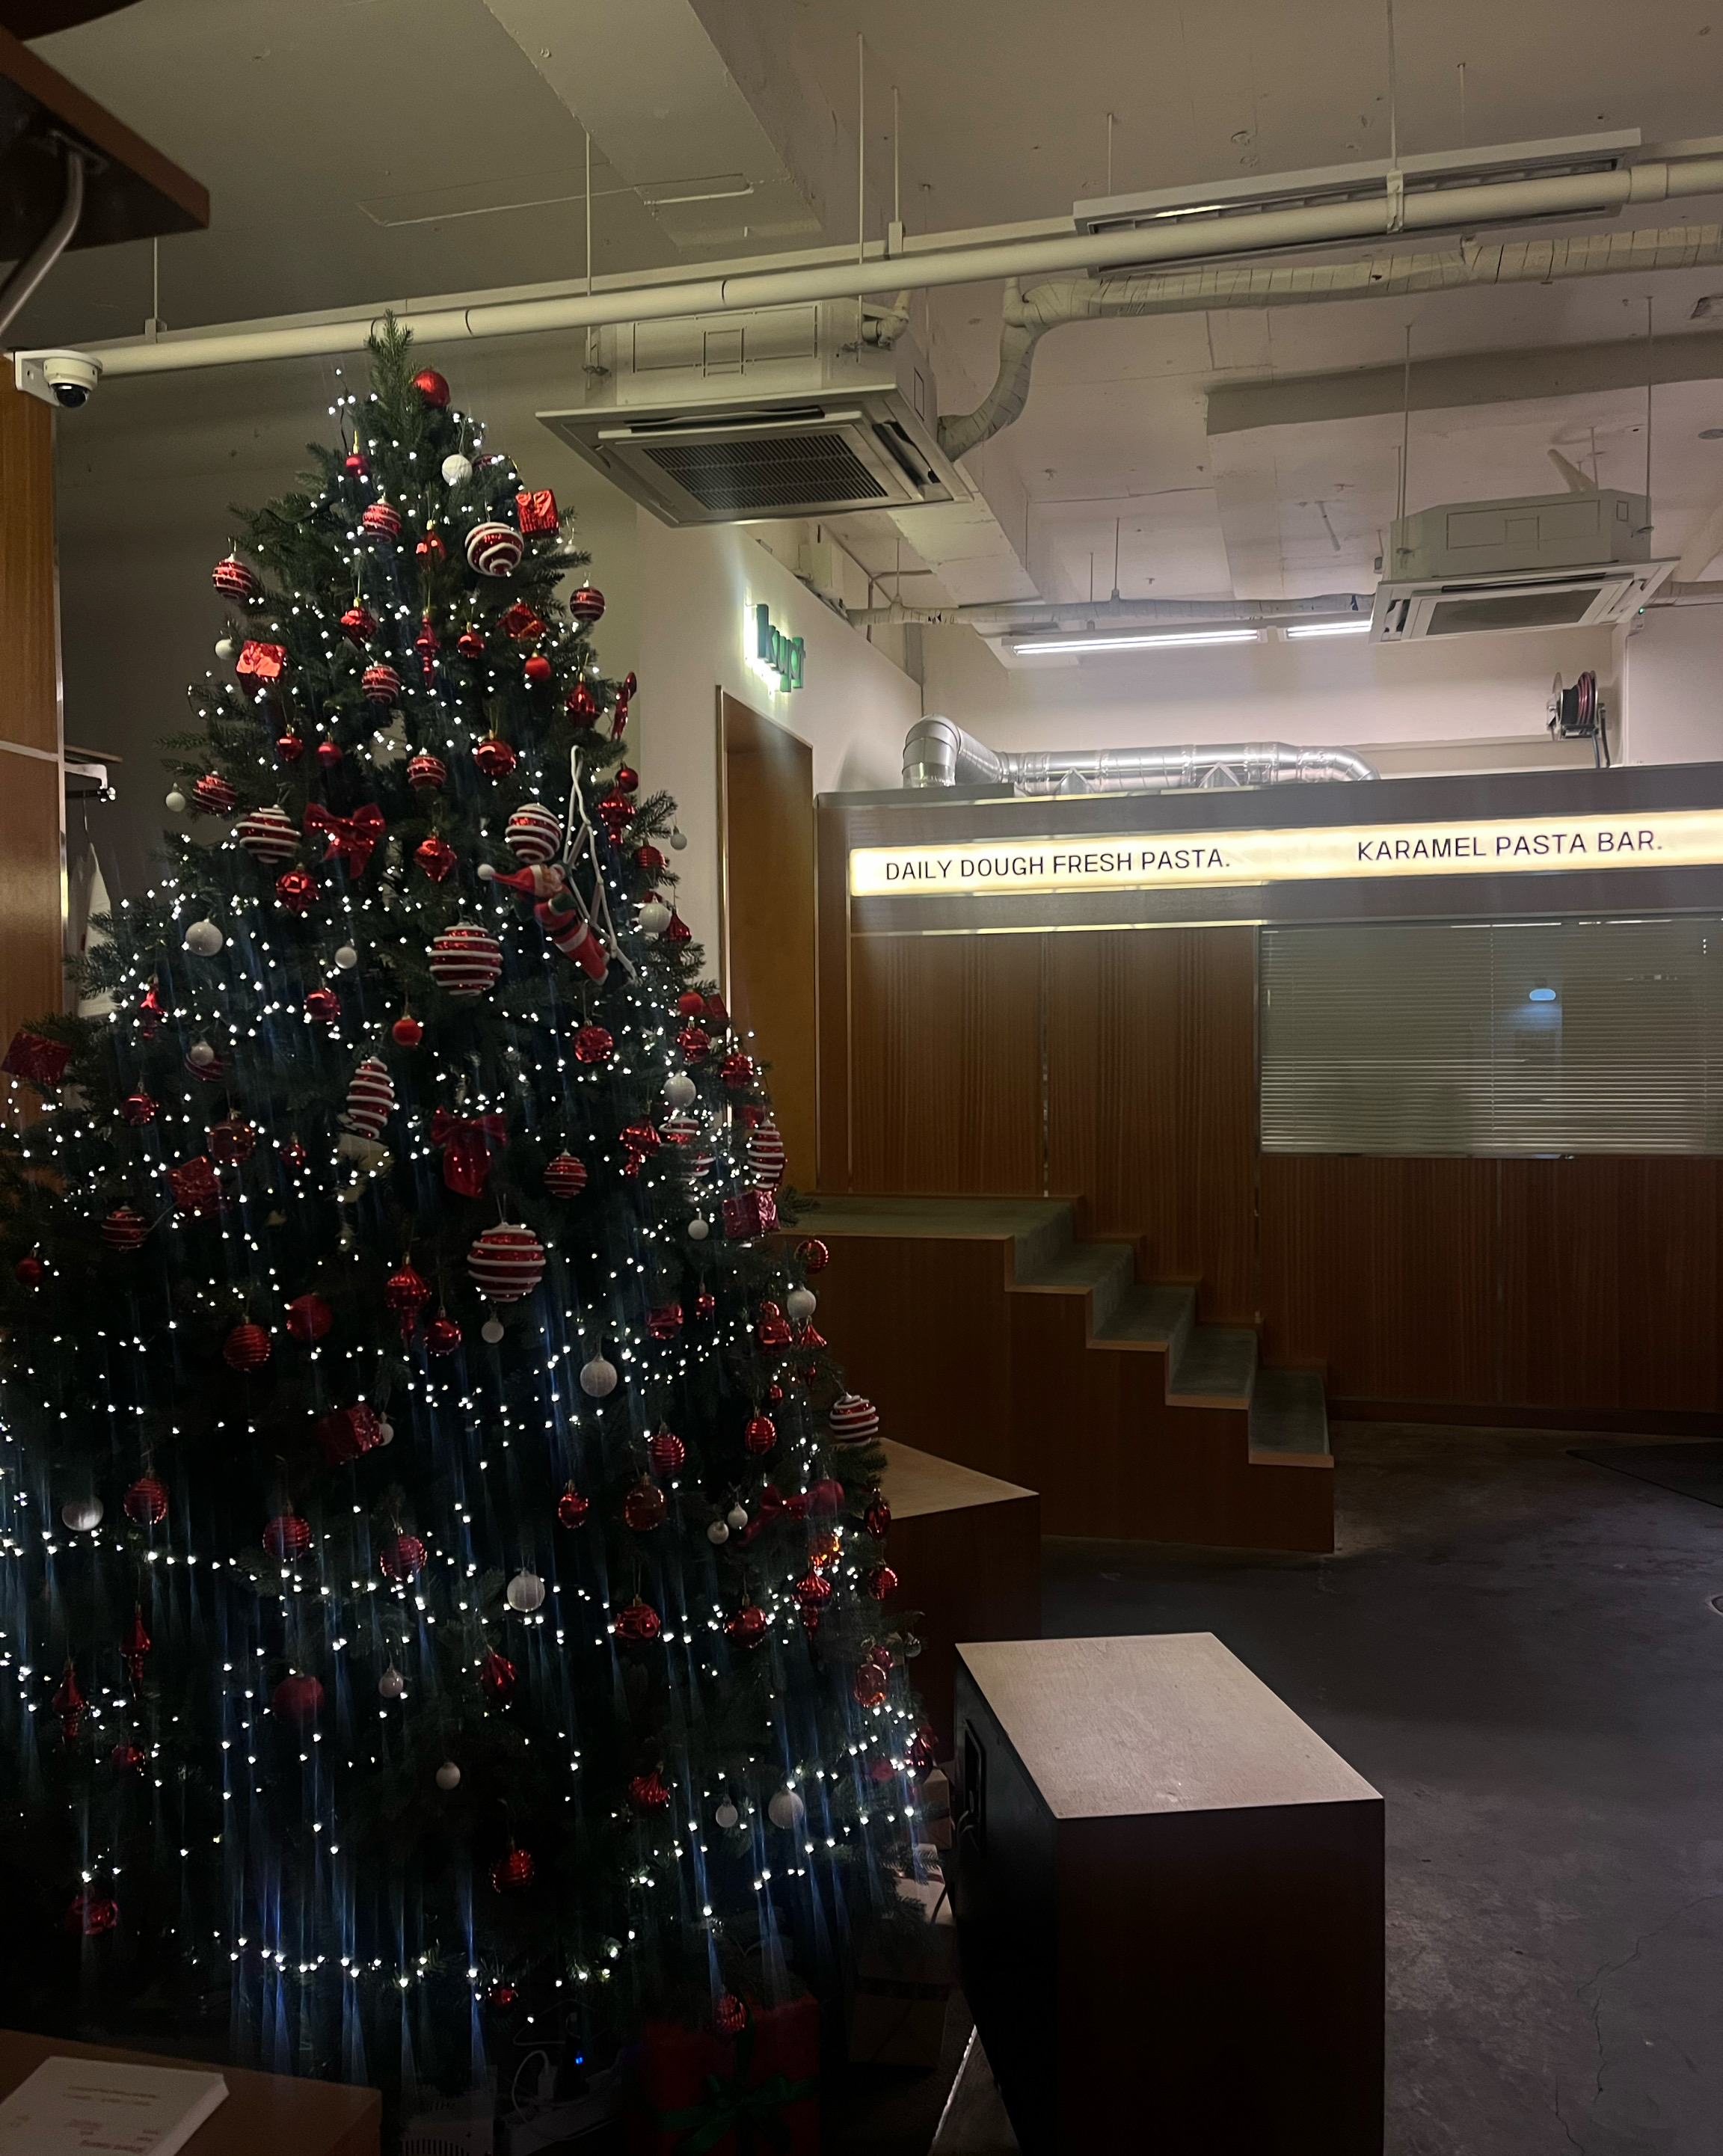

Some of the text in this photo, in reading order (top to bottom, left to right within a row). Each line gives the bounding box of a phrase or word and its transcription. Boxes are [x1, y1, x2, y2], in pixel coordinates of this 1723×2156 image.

[1358, 830, 1662, 862] KARAMEL PASTA BAR.
[886, 848, 1230, 880] DAILY DOUGH FRESH PASTA.
